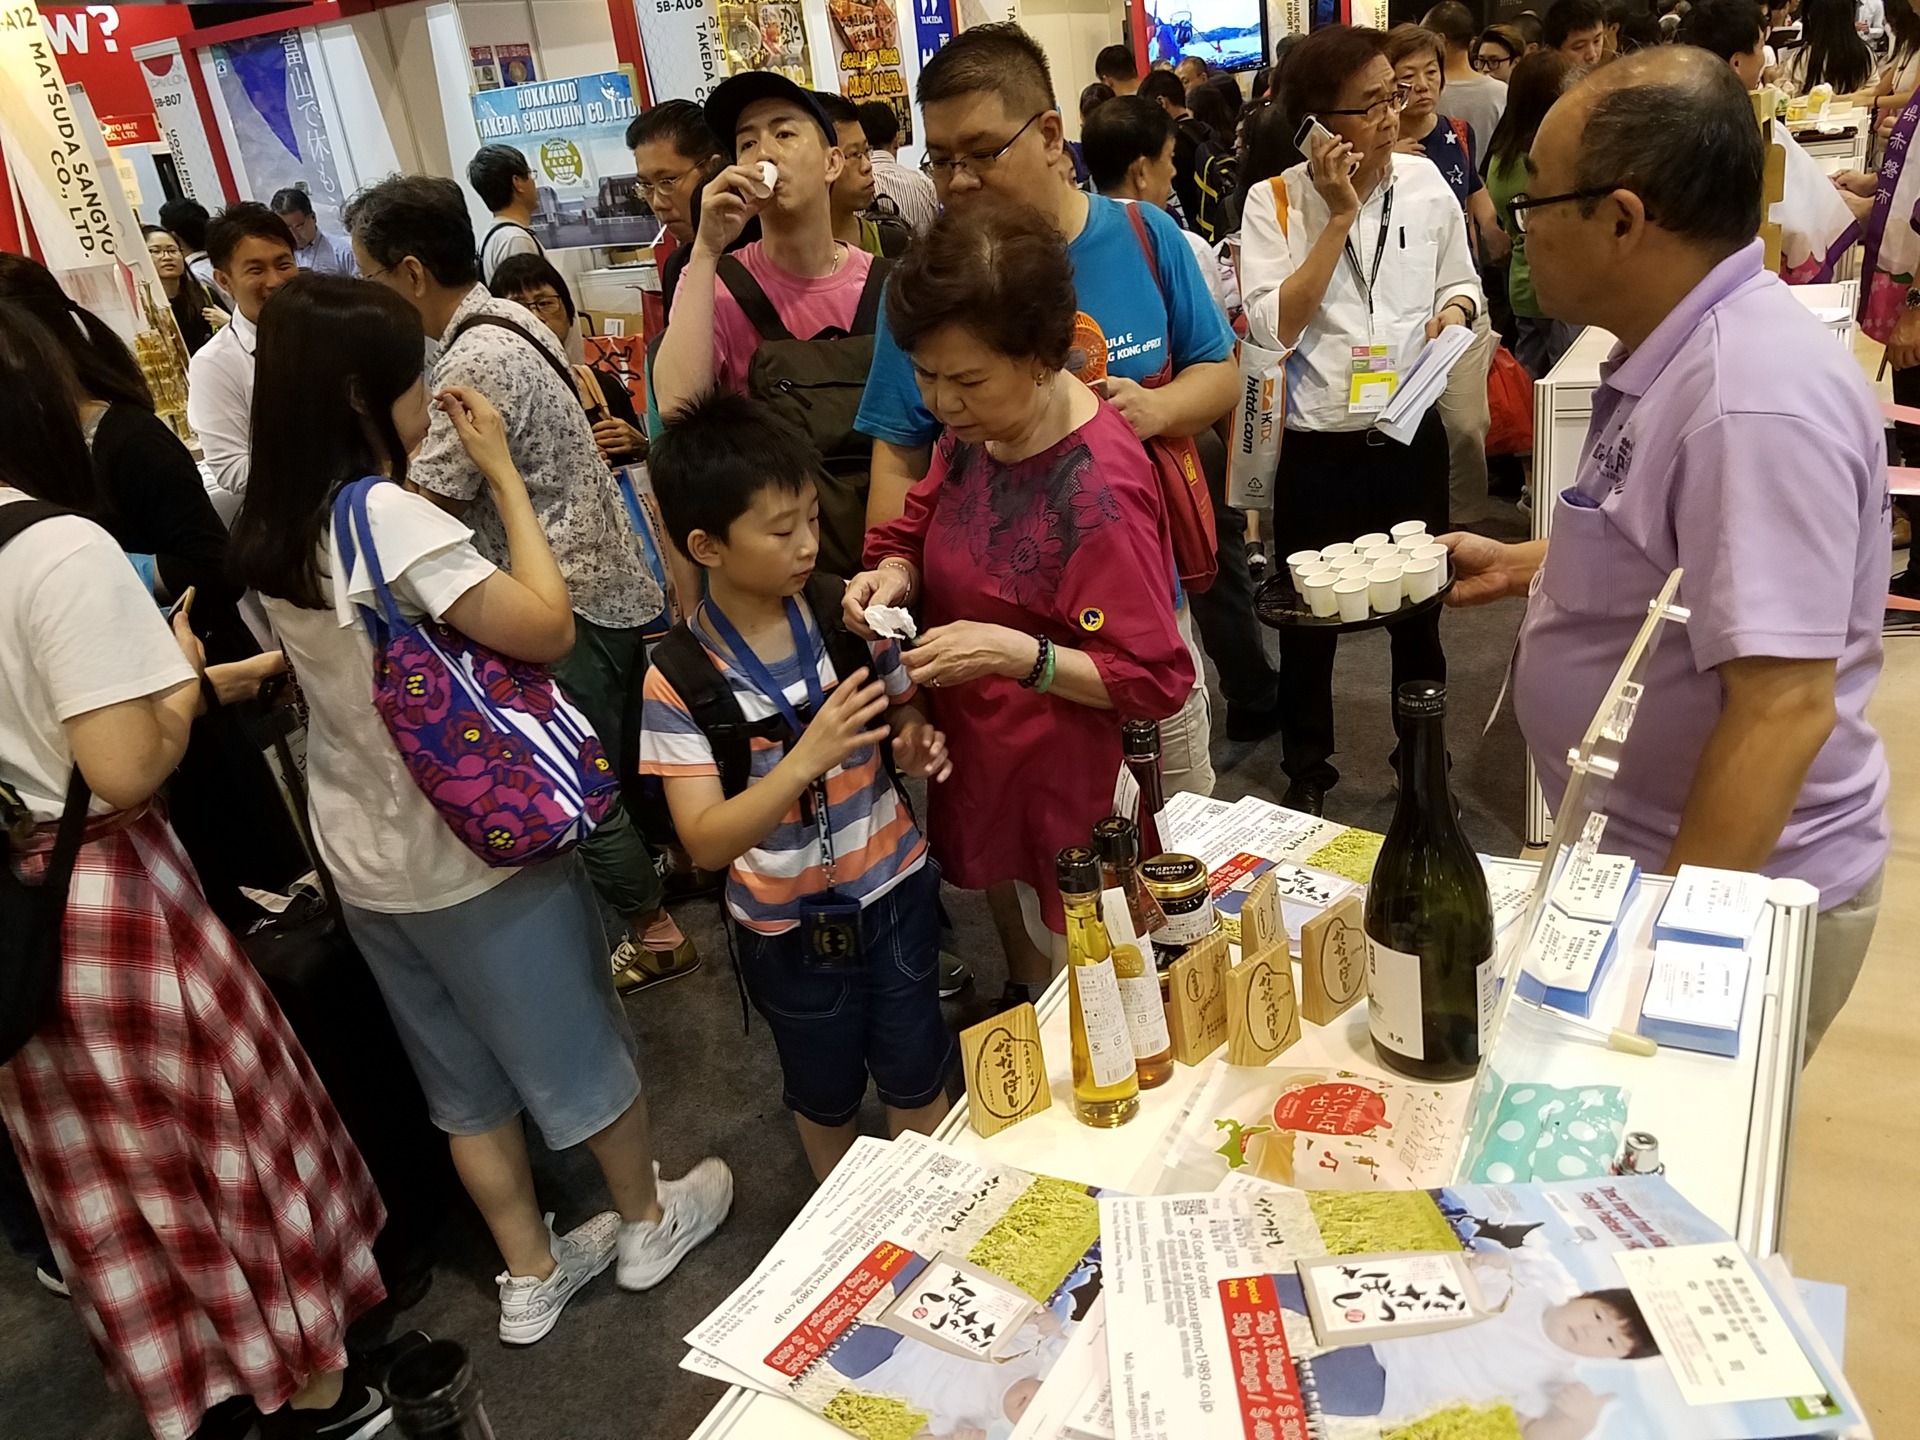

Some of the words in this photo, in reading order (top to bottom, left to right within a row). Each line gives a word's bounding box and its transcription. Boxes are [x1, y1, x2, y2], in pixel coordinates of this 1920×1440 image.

[920, 16, 943, 24] TAKEDA
[696, 22, 715, 81] TAKEDA
[848, 74, 871, 98] MISO
[873, 71, 902, 96] TASTE
[517, 80, 579, 110] HOKKAIDO
[476, 116, 521, 138] TAKEDA
[523, 108, 585, 133] SHOKUHIN
[29, 42, 81, 156] MATSUDA
[73, 163, 115, 255] SANGYO
[171, 128, 186, 165] UOZU
[545, 158, 579, 167] HACCP
[51, 150, 71, 199] CO.,
[69, 206, 95, 259] LTD.
[1126, 333, 1133, 342] E
[1117, 344, 1141, 360] KONG
[1243, 375, 1259, 454] hktdc.com
[1261, 411, 1272, 445] HKTDC
[906, 1183, 916, 1194] or
[909, 1186, 925, 1202] QR
[884, 1191, 907, 1215] email
[890, 1197, 914, 1222] Code
[938, 1171, 1002, 1239] ななつぼし
[866, 1221, 878, 1233] at
[875, 1212, 887, 1224] us
[880, 1217, 895, 1232] for
[859, 1228, 883, 1252] order
[1176, 1229, 1187, 1238] or
[1189, 1227, 1202, 1240] QR
[874, 1241, 893, 1261] Price
[1177, 1238, 1191, 1257] email
[1191, 1239, 1206, 1260] Code
[879, 1246, 904, 1273] Special
[1180, 1257, 1192, 1271] us
[1195, 1260, 1208, 1274] for
[772, 1228, 872, 1327] japazaar@nmc1989.co.jp
[1183, 1271, 1194, 1281] at
[837, 1285, 852, 1300] X
[1197, 1274, 1212, 1300] order
[1227, 1280, 1239, 1299] Price
[1244, 1277, 1261, 1305] Special
[850, 1292, 865, 1307] X
[743, 1302, 758, 1318] Tel:
[805, 1291, 844, 1332] 2bags
[819, 1298, 857, 1338] 3bags
[834, 1314, 864, 1345] FREE
[1232, 1312, 1252, 1338] 5kg
[1255, 1310, 1276, 1337] 2kg
[789, 1331, 805, 1347] $
[803, 1339, 819, 1355] $
[1181, 1280, 1215, 1414] japazaar@nmc1989.co.jp
[1238, 1337, 1257, 1349] X
[1261, 1336, 1281, 1348] X
[783, 1348, 809, 1375] 305
[786, 1337, 841, 1395] DELIVERY
[1122, 1351, 1135, 1371] Mail:
[1239, 1349, 1262, 1393] 2bags
[1264, 1347, 1288, 1392] 3bags
[1291, 1353, 1317, 1388] FREE
[1246, 1393, 1268, 1402] /
[1272, 1391, 1294, 1400] /
[1152, 1408, 1166, 1426] Tel:
[1249, 1406, 1272, 1418] $
[1275, 1404, 1299, 1418] $
